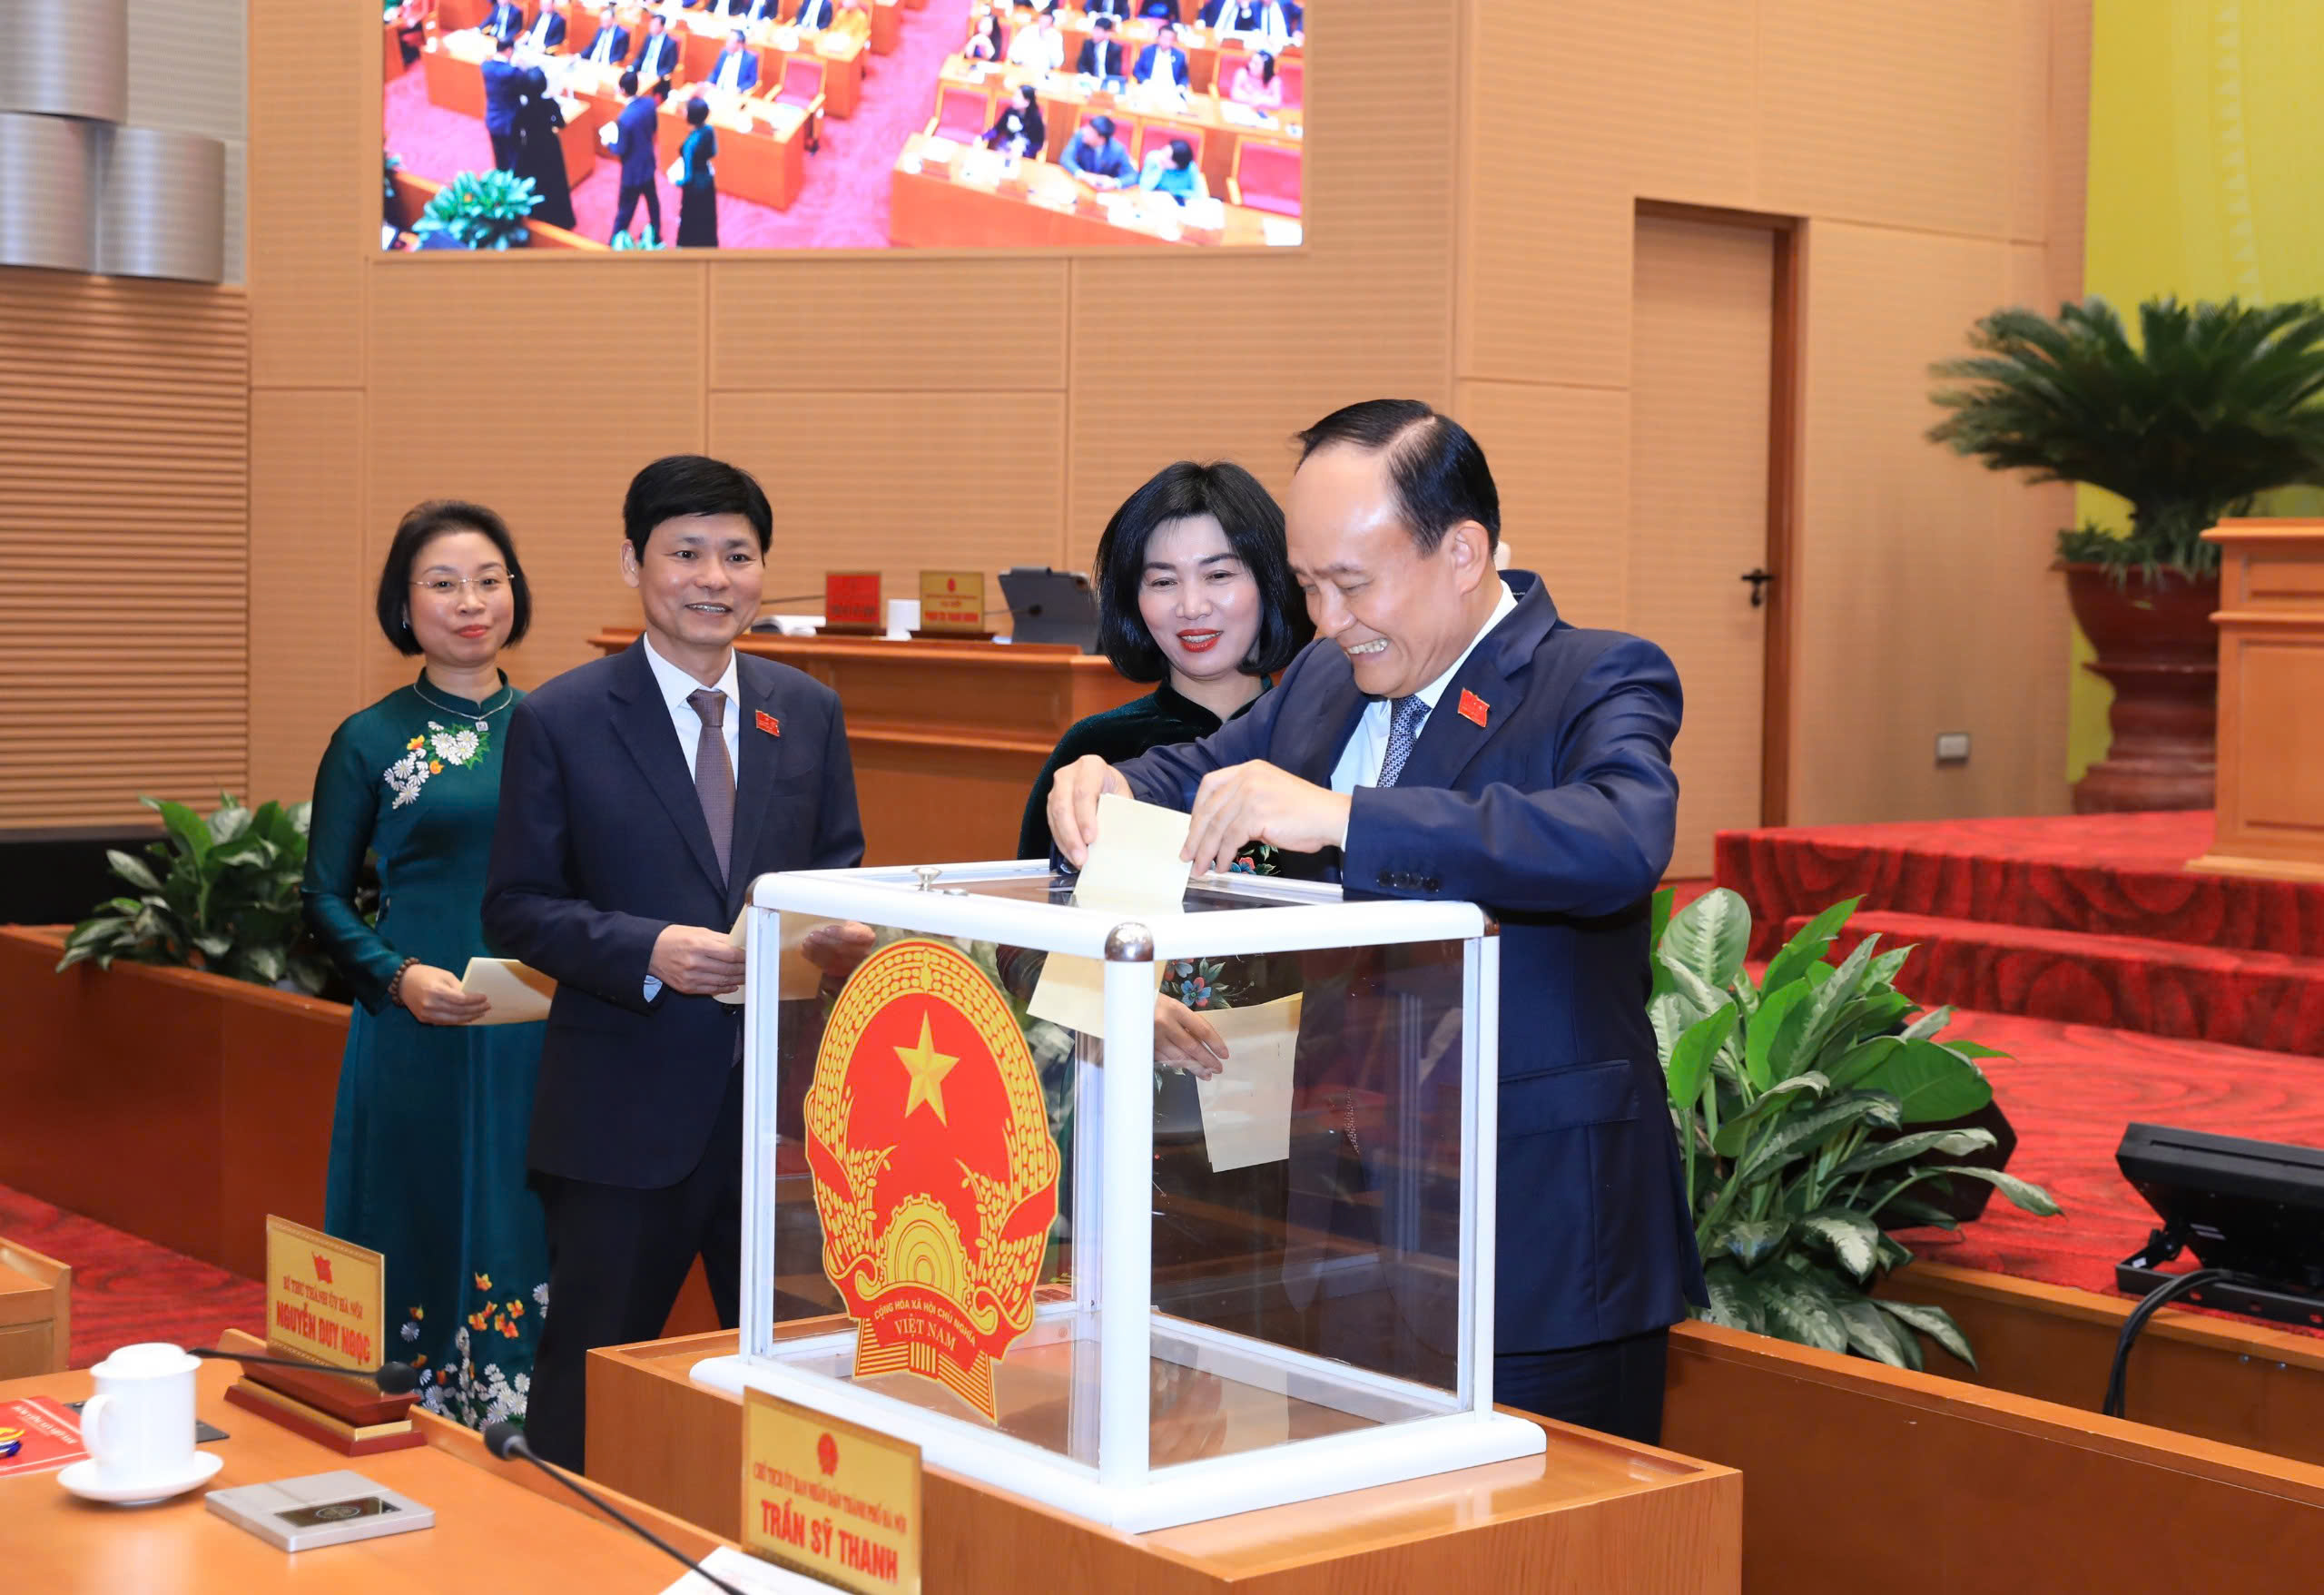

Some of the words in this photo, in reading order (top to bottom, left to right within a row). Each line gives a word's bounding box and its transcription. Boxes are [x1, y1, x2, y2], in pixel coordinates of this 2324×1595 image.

[276, 1299, 317, 1343] NGUYỄN
[873, 1301, 893, 1320] CỘNG
[911, 1297, 922, 1311] XÃ
[923, 1300, 936, 1315] HỘI
[938, 1307, 953, 1324] CHỦ
[953, 1318, 976, 1348] NGHĨA
[894, 1313, 925, 1338] VIỆT
[928, 1321, 957, 1351] NAM
[810, 1516, 833, 1561] SỸ
[838, 1528, 899, 1585] THANH
